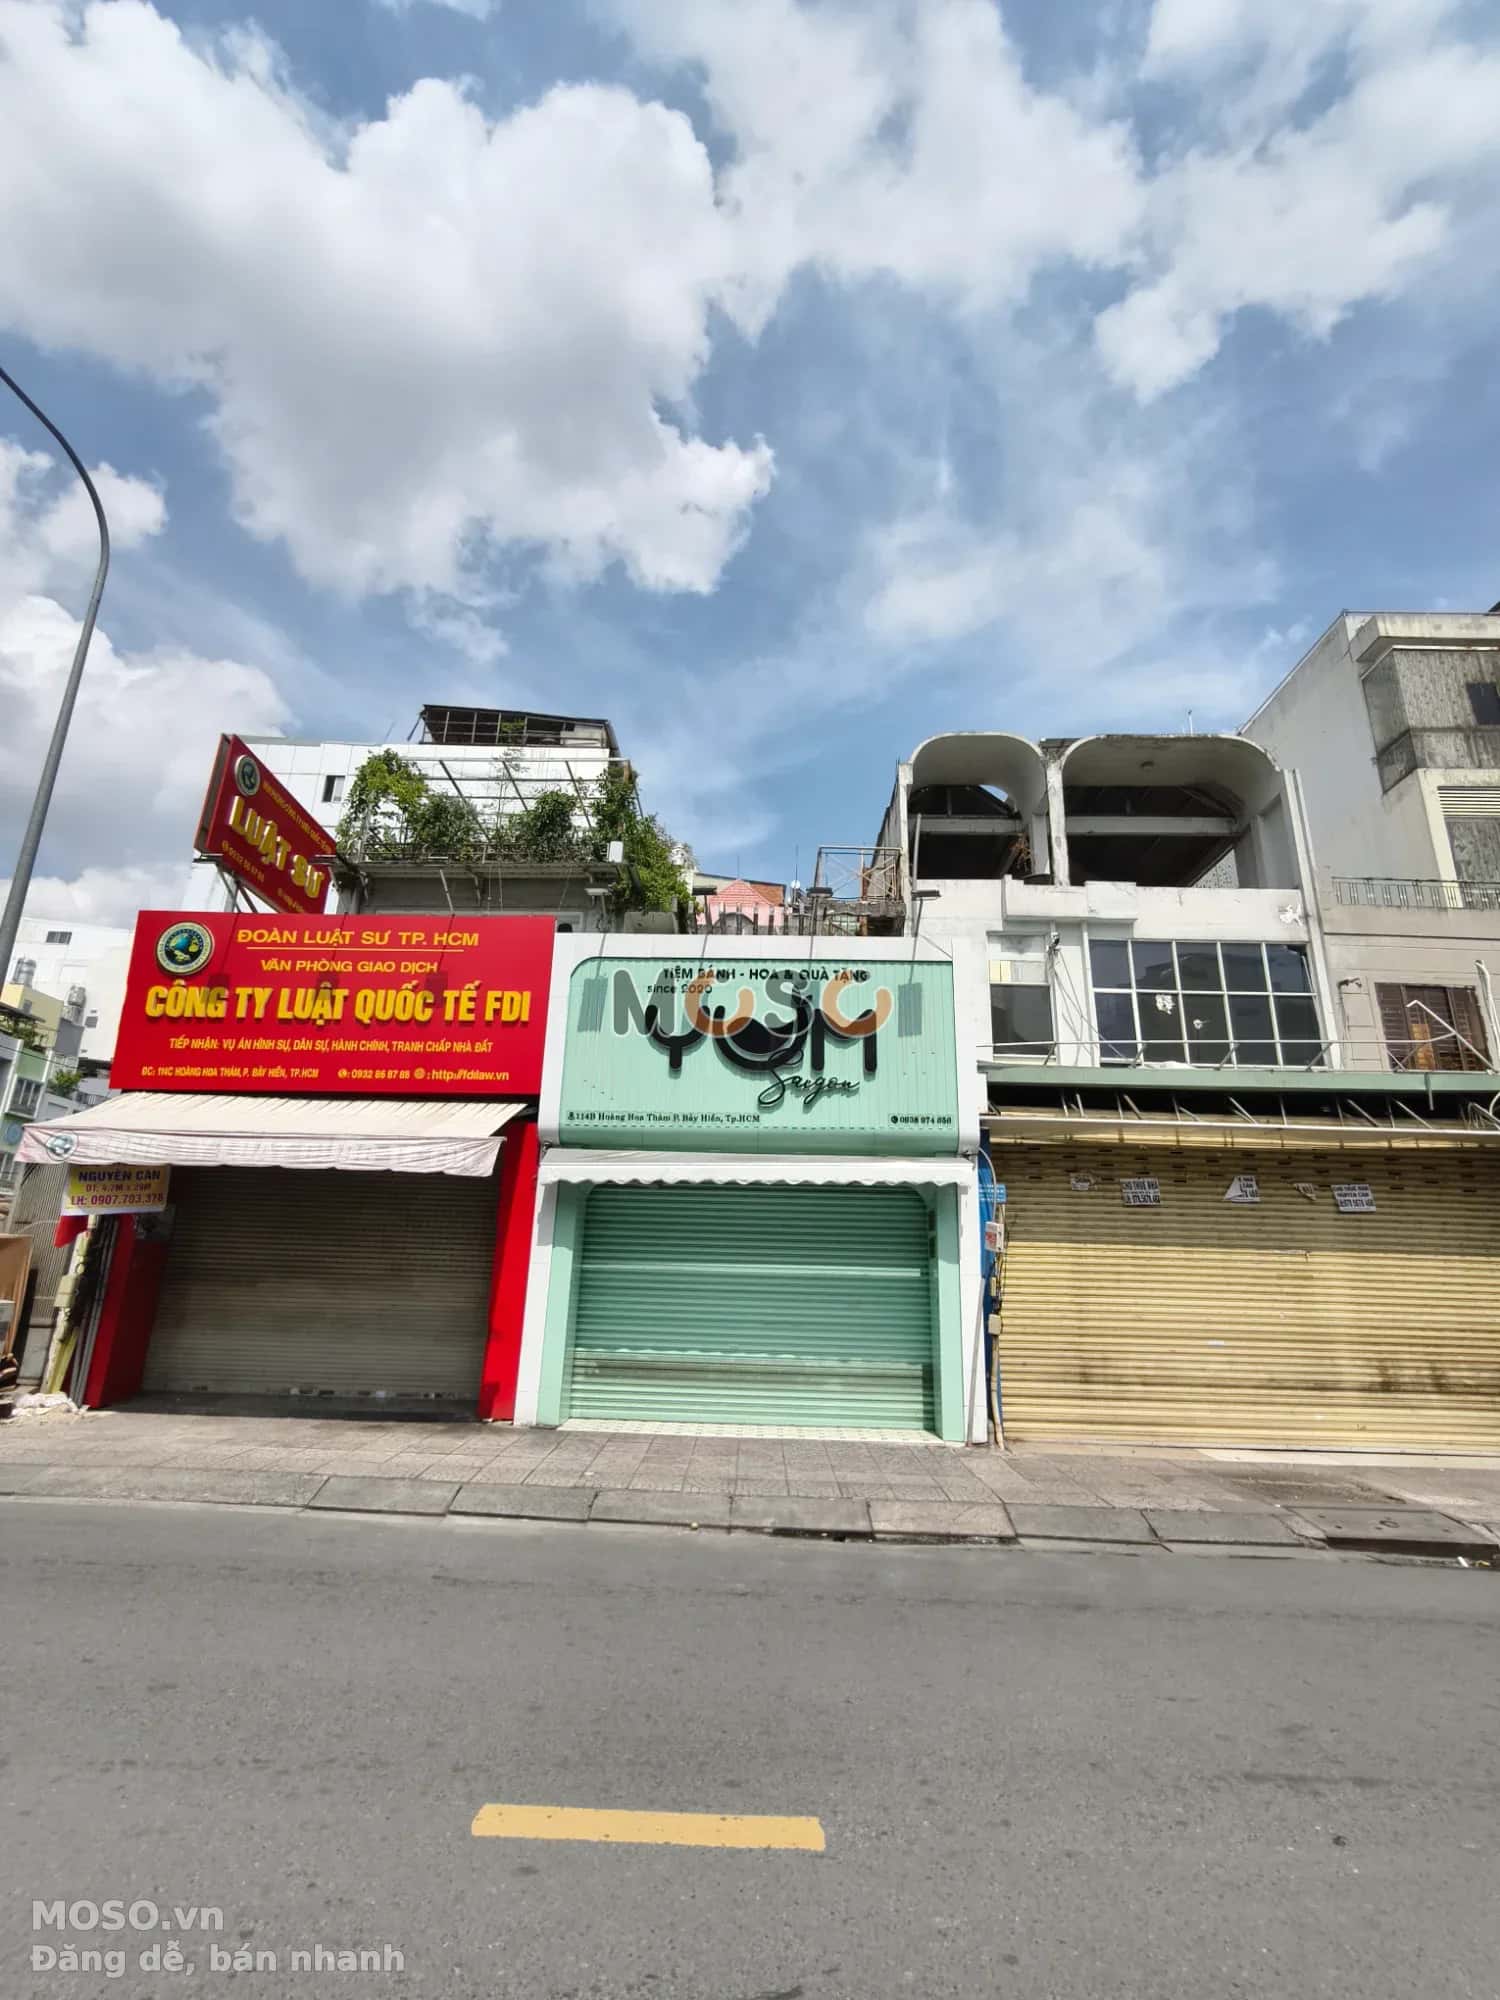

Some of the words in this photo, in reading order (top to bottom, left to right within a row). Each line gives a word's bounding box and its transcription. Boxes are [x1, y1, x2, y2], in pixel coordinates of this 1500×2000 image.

[229, 796, 292, 870] LUẬT
[291, 854, 325, 898] SƯ
[237, 928, 297, 944] ĐOÀN
[303, 928, 354, 946] LUẬT
[361, 930, 391, 945] SƯ
[398, 931, 428, 945] TP.
[433, 933, 479, 946] HCM
[261, 959, 292, 972] VĂN
[295, 959, 353, 973] PHÒNG
[357, 961, 396, 973] GIAO
[399, 961, 438, 975] DỊCH
[663, 966, 693, 980] TIỆM
[699, 966, 736, 980] BÁNH
[749, 970, 779, 980] HOA
[799, 966, 829, 981] QUÀ
[647, 984, 676, 994] since
[145, 979, 229, 1018] CÔNG
[235, 987, 273, 1018] TY
[277, 981, 349, 1026] LUẬT
[354, 980, 434, 1024] QUỐC
[443, 980, 482, 1021] TẾ
[485, 991, 531, 1022] FDI
[169, 1034, 190, 1049] TIẾP
[222, 1038, 235, 1051] VỤ
[238, 1036, 252, 1050] ÁN
[332, 1039, 358, 1051] HÀNH
[391, 1041, 424, 1053] TRANH
[426, 1038, 451, 1053] CHẤP
[453, 1040, 472, 1053] NHÀ
[474, 1038, 494, 1053] ĐẤT
[758, 1047, 860, 1106] Saigon
[71, 1196, 87, 1206] LH:
